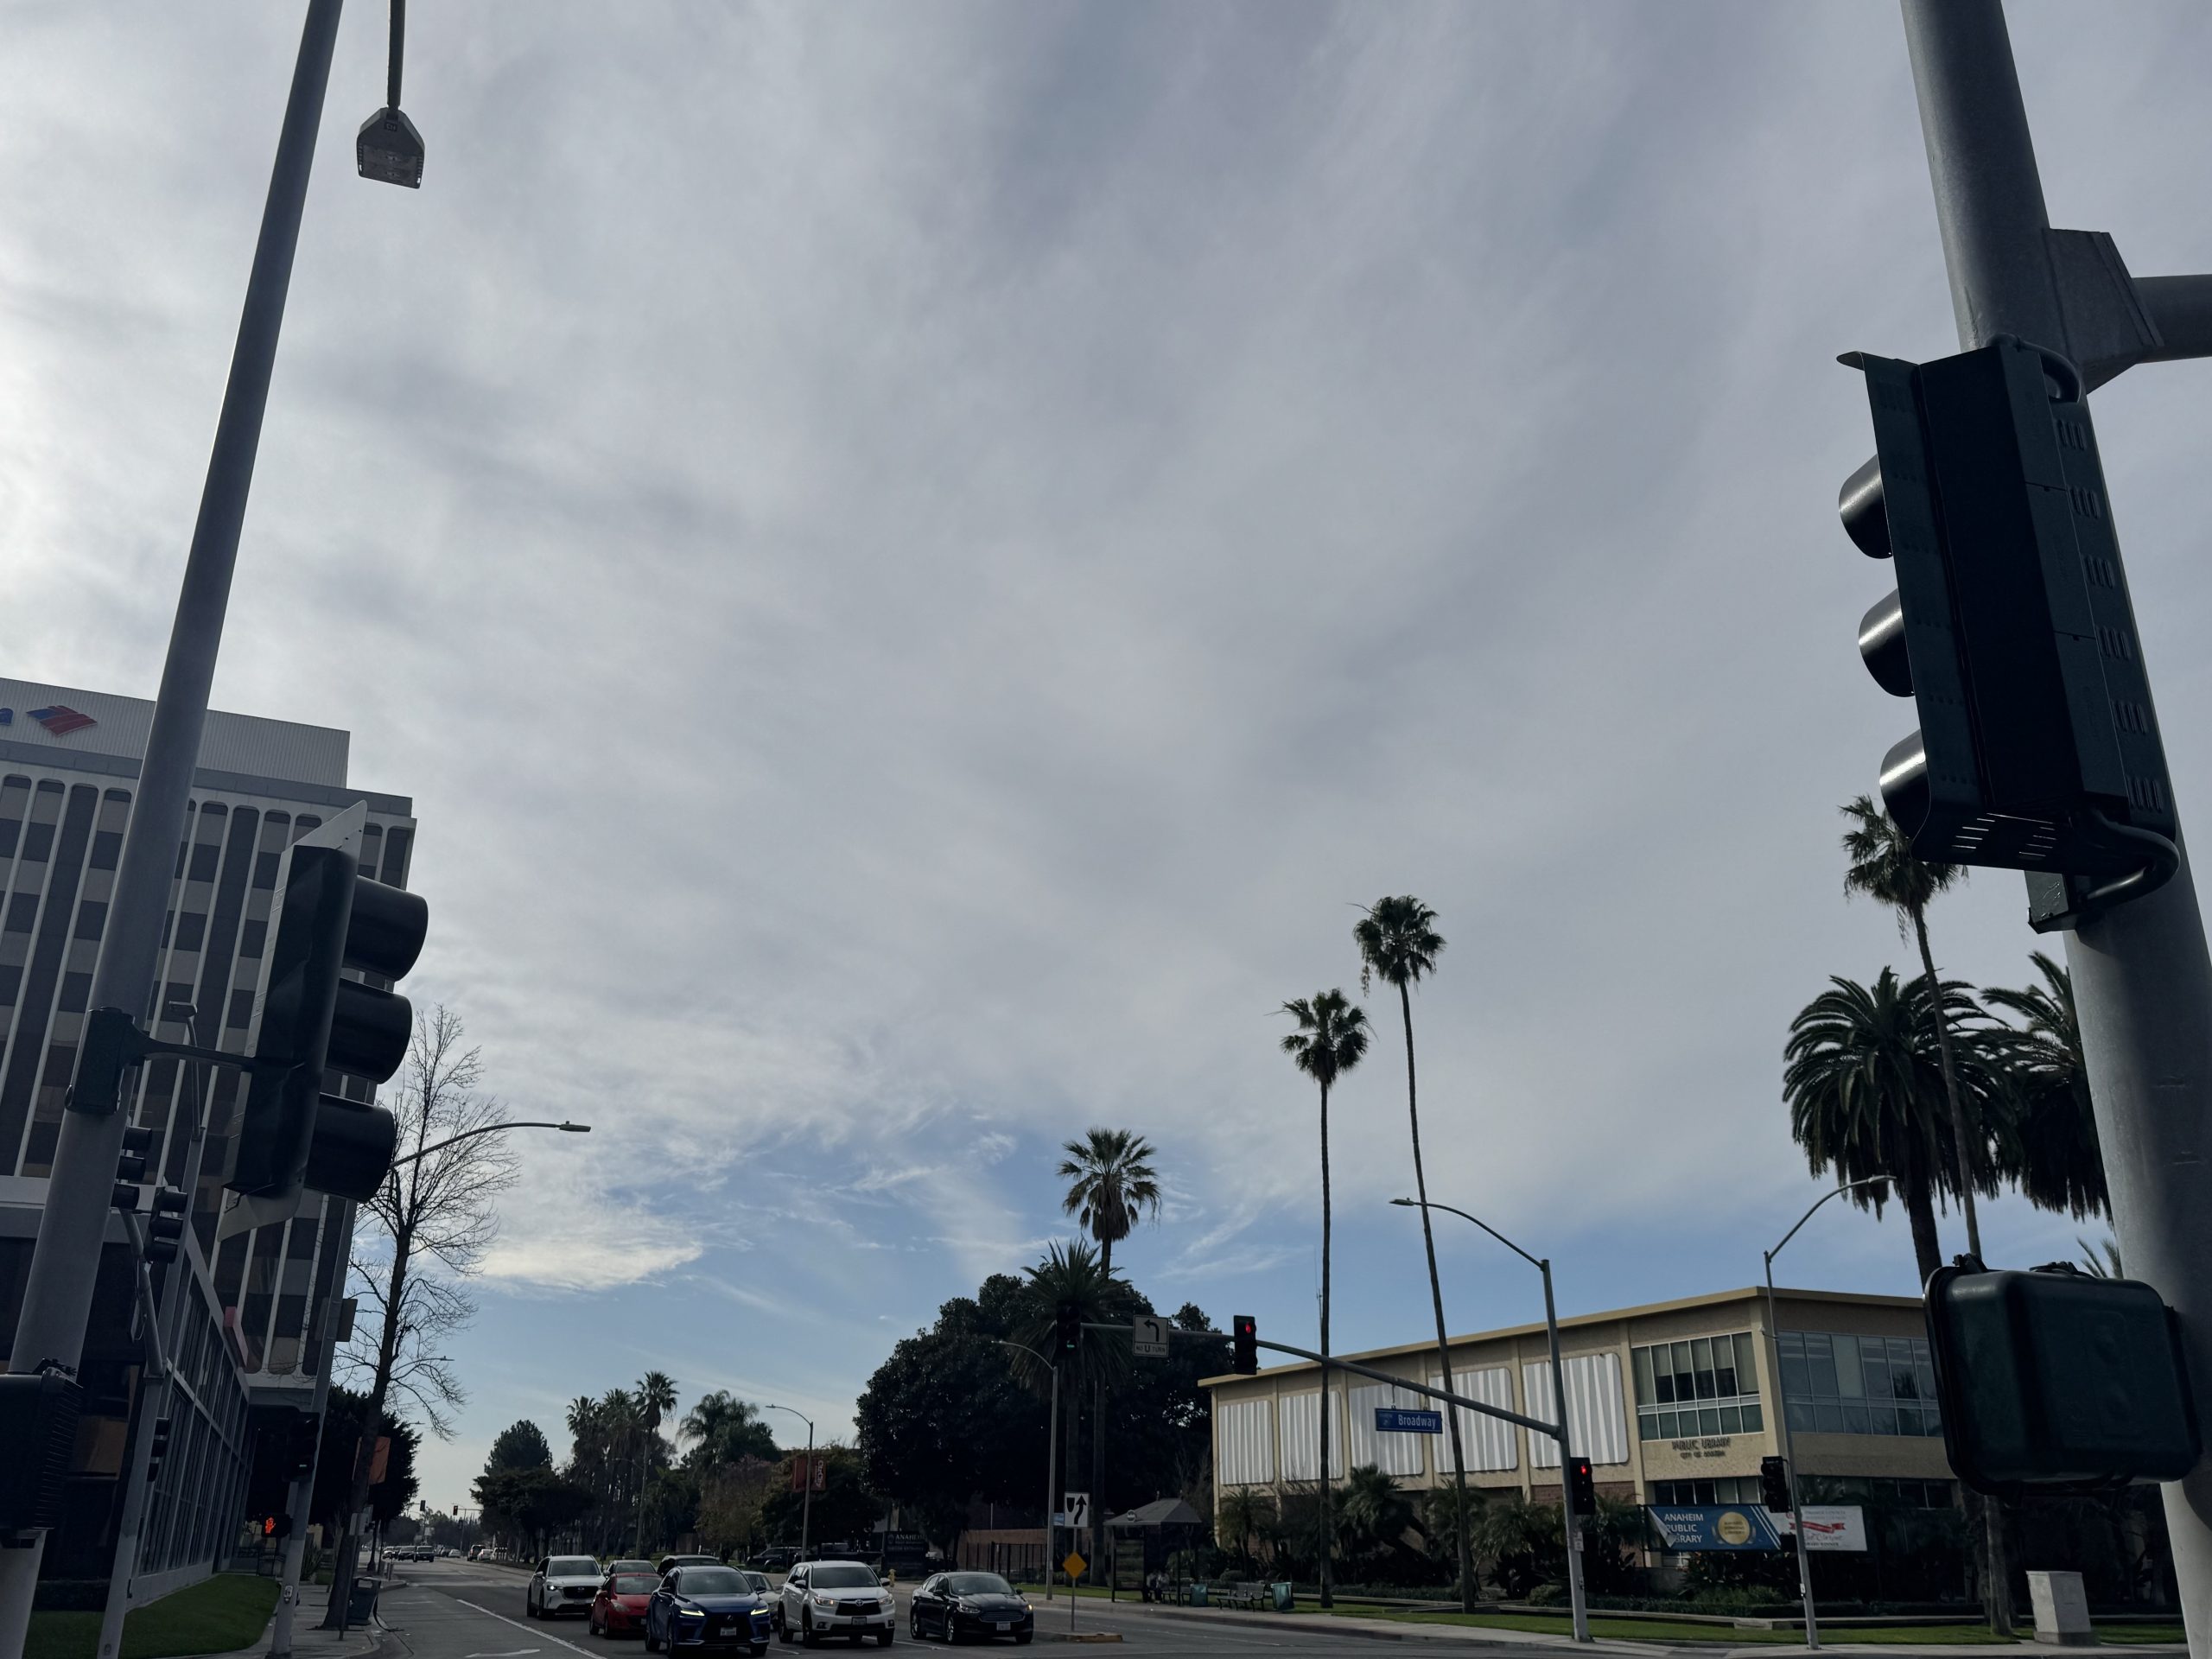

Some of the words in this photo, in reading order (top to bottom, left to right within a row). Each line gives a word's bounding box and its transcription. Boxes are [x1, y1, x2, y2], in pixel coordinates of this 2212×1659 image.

[1398, 1414, 1436, 1430] Broadway
[1672, 1440, 1699, 1451] PUBLIC
[1664, 1513, 1704, 1522] ANAHEIM
[1666, 1523, 1698, 1533] PUBLIC
